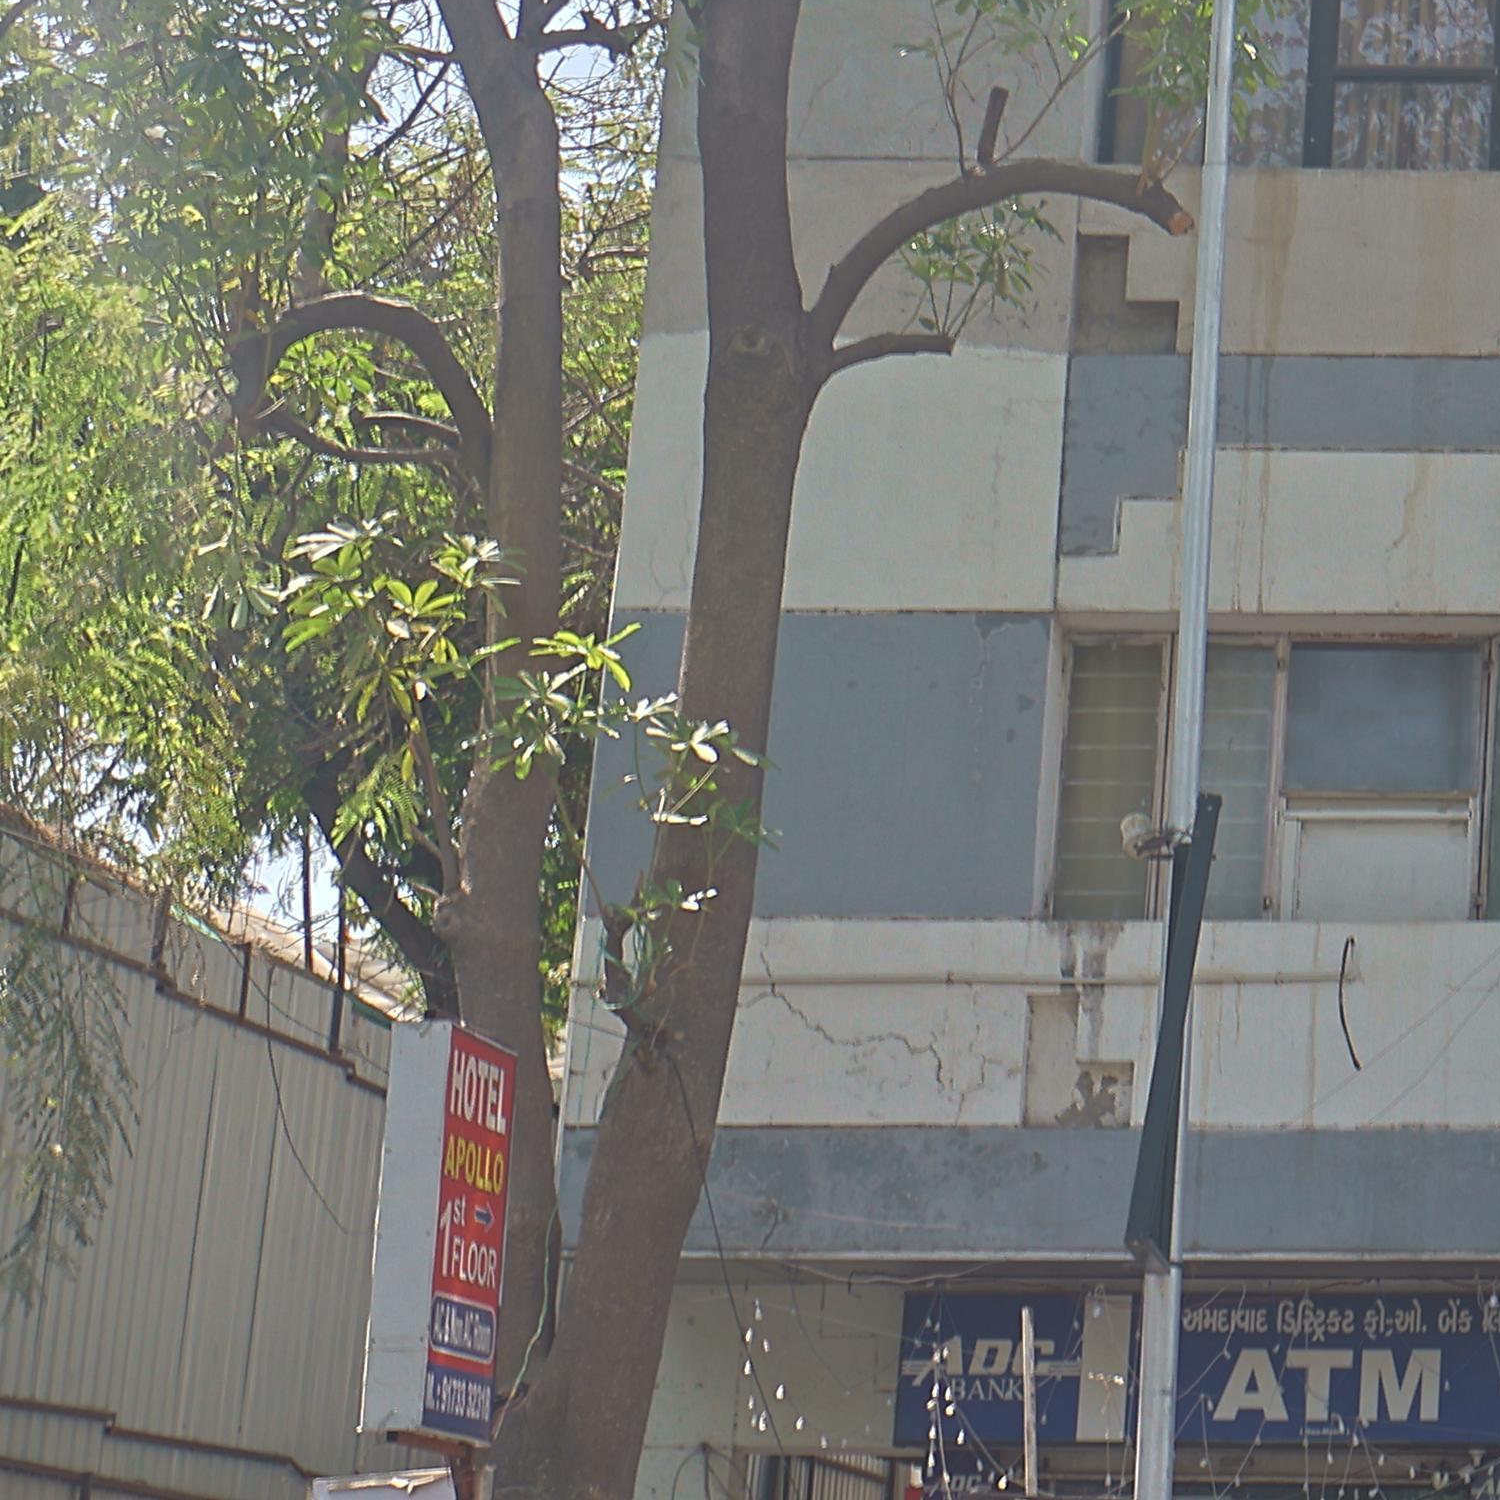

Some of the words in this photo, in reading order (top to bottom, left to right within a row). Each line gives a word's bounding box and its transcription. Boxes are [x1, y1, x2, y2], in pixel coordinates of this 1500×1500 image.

[450, 1048, 506, 1135] HOTEL
[444, 1133, 505, 1195] APOLLO
[450, 1235, 498, 1289] FLOOR
[1182, 1308, 1268, 1333] અમદાવાદ
[1438, 1299, 1473, 1334] બેંક
[912, 1334, 1055, 1386] ADC
[1212, 1348, 1441, 1422] ATM
[951, 1378, 1025, 1400] BANK
